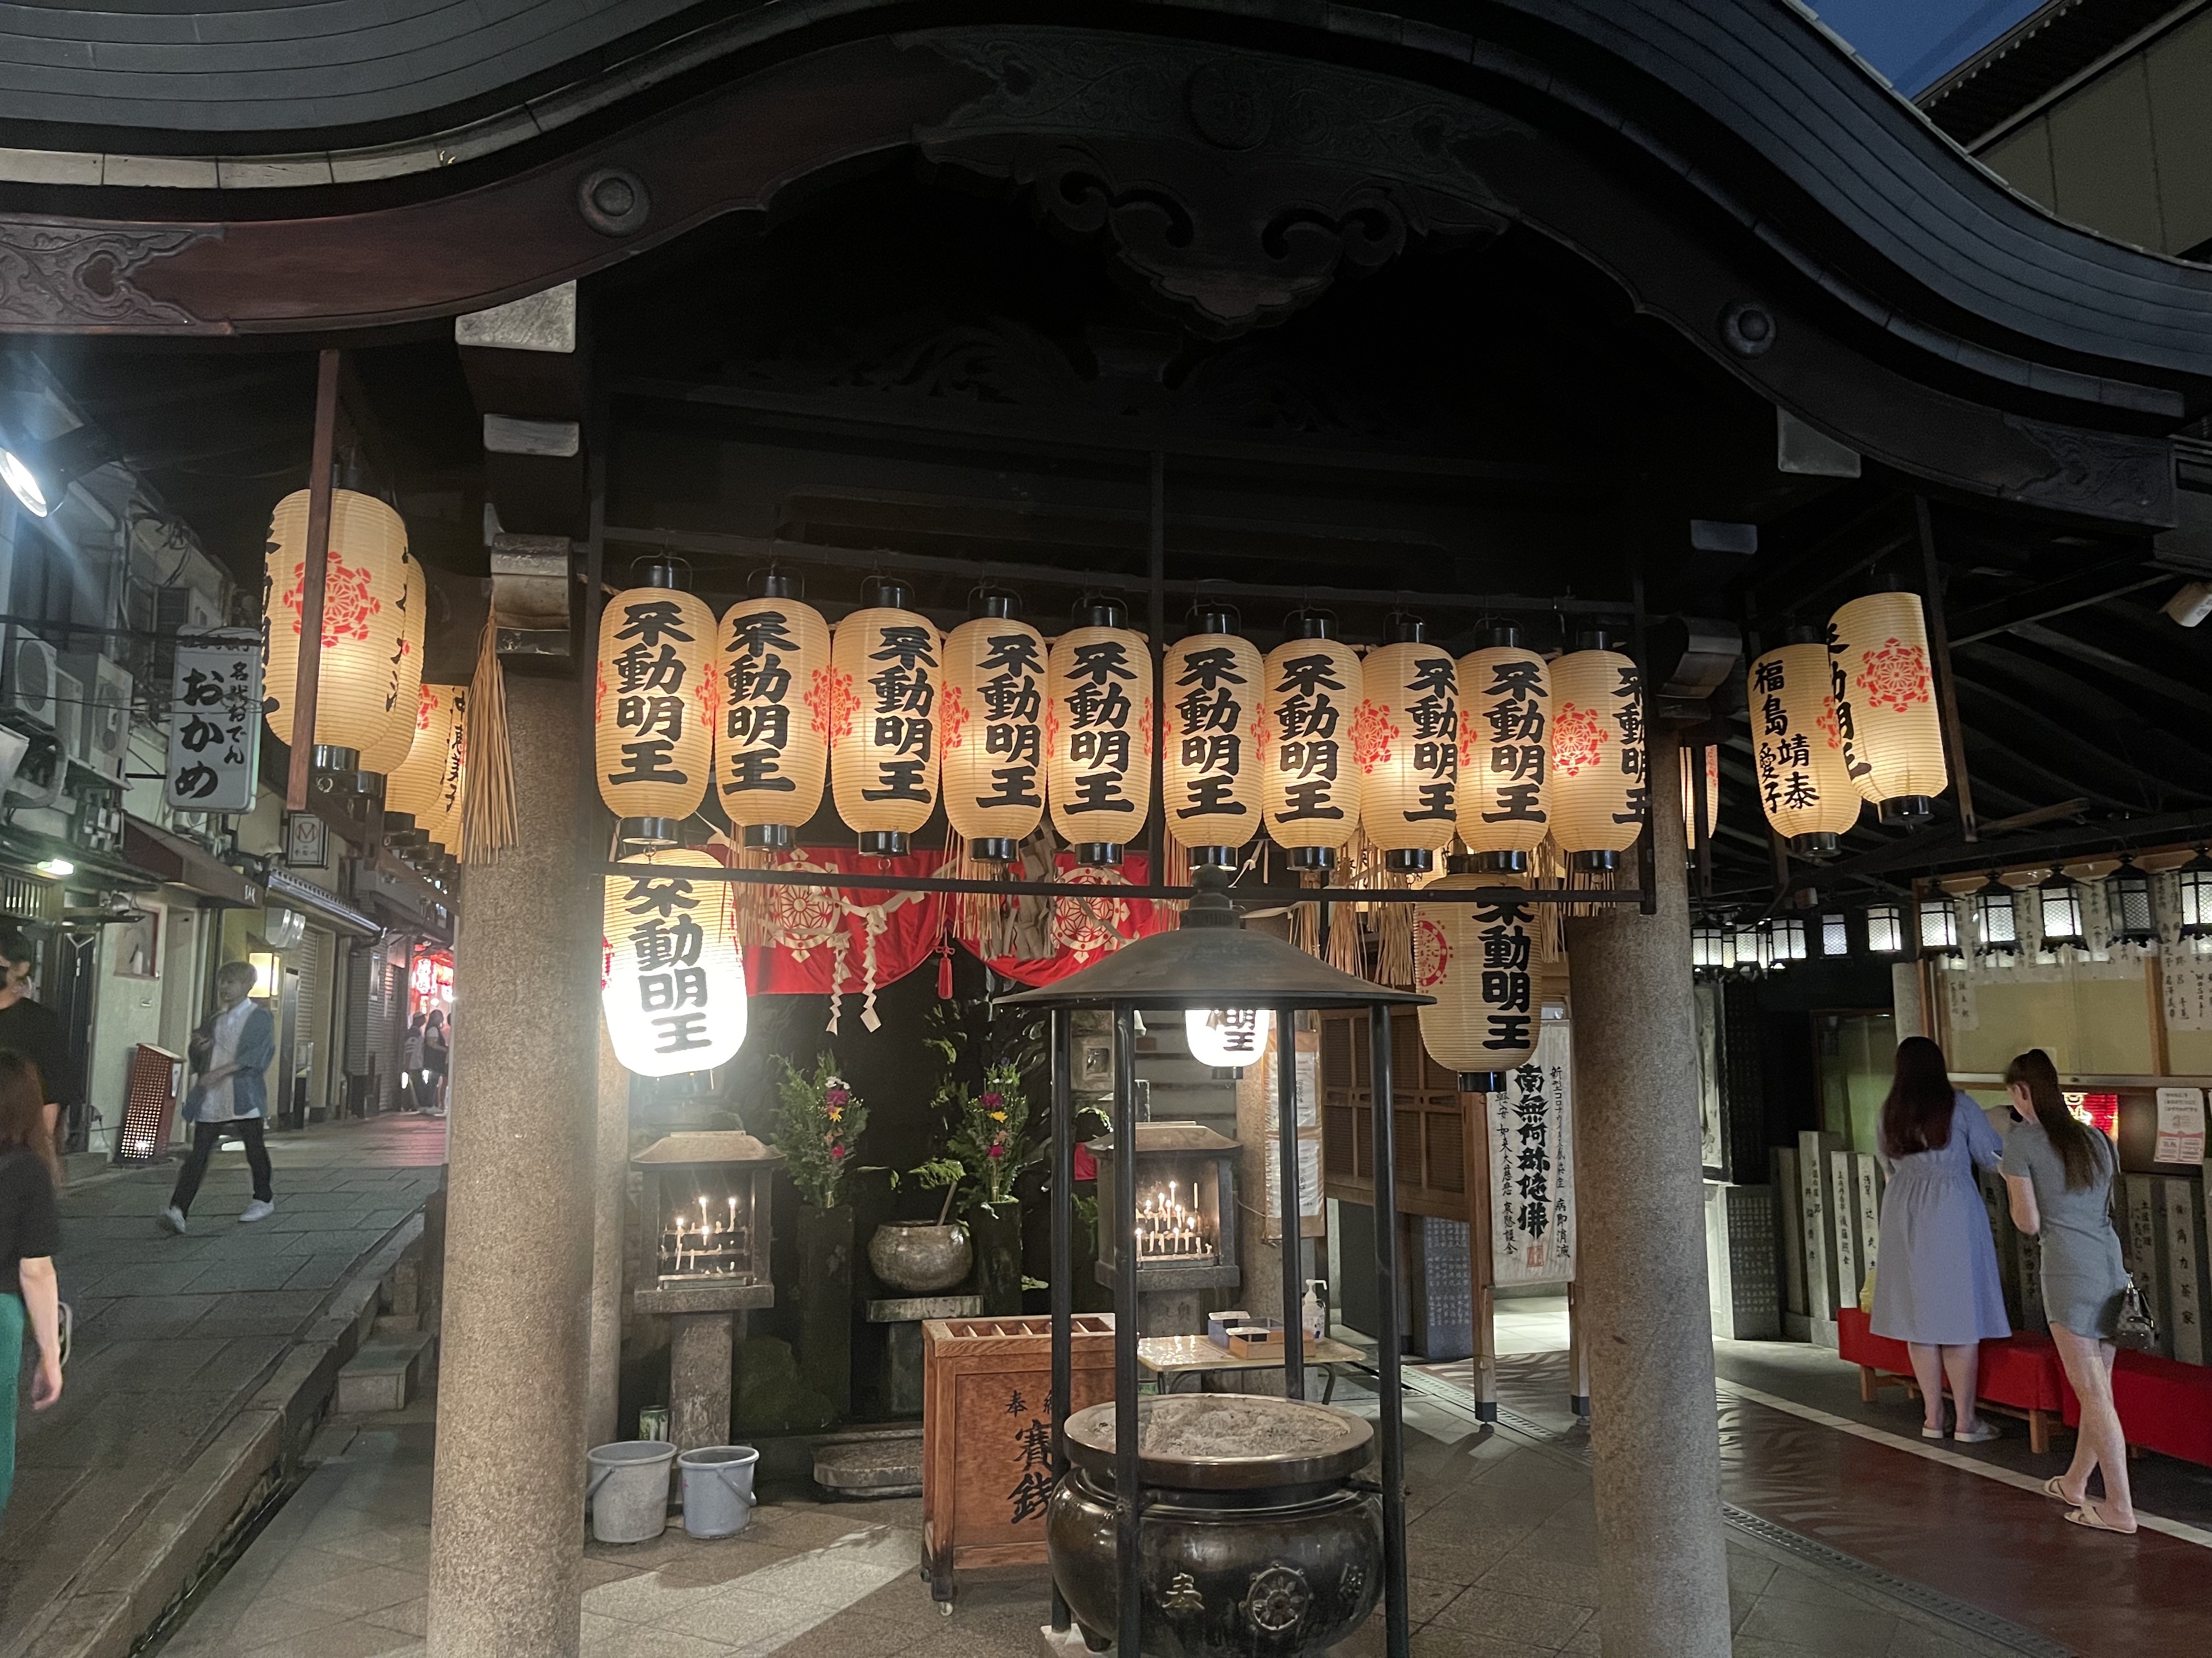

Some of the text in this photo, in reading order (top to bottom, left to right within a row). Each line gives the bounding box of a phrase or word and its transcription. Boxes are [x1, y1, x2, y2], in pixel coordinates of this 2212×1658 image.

[175, 667, 224, 799] おかめ
[608, 602, 695, 785] 不動明王
[722, 612, 800, 795] 不動明王
[861, 626, 939, 803] 不動明王
[976, 634, 1045, 808] 不動明王
[1063, 642, 1138, 814] 不動明王
[1175, 648, 1248, 818] 不動明王
[1274, 654, 1346, 823] 不動明王
[1403, 658, 1459, 822] 不動明王
[1481, 661, 1549, 823] 不動明王
[1753, 660, 1788, 737] 福島
[1759, 742, 1782, 814] 愛子
[624, 878, 713, 1054] 不動明王
